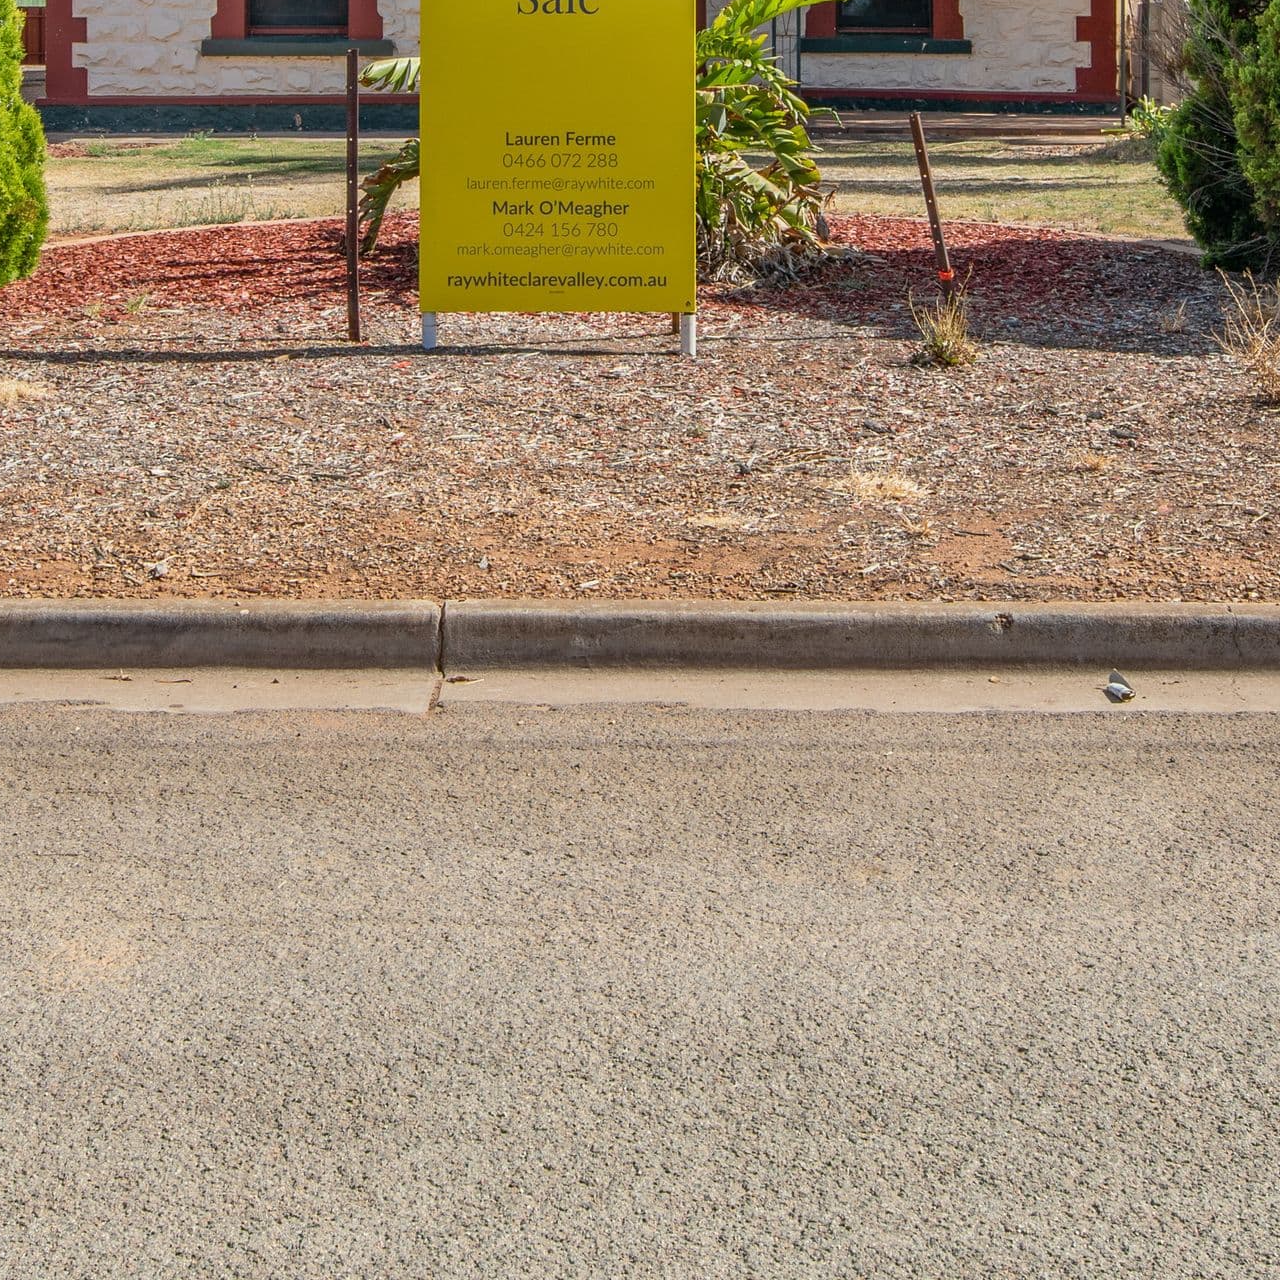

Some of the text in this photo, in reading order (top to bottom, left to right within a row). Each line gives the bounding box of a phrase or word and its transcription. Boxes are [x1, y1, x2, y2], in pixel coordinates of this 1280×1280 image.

[505, 131, 617, 147] Lauren Ferme
[502, 153, 619, 168] 0466 072 288
[466, 177, 655, 192] lauren.ferme@raywhite.com
[492, 200, 630, 219] Mark O'Meagher
[502, 222, 619, 238] 0424 156 780
[456, 243, 665, 258] mark.omeagher@raywhite.com
[447, 272, 668, 290] raywhiteclarevalley.com.au
